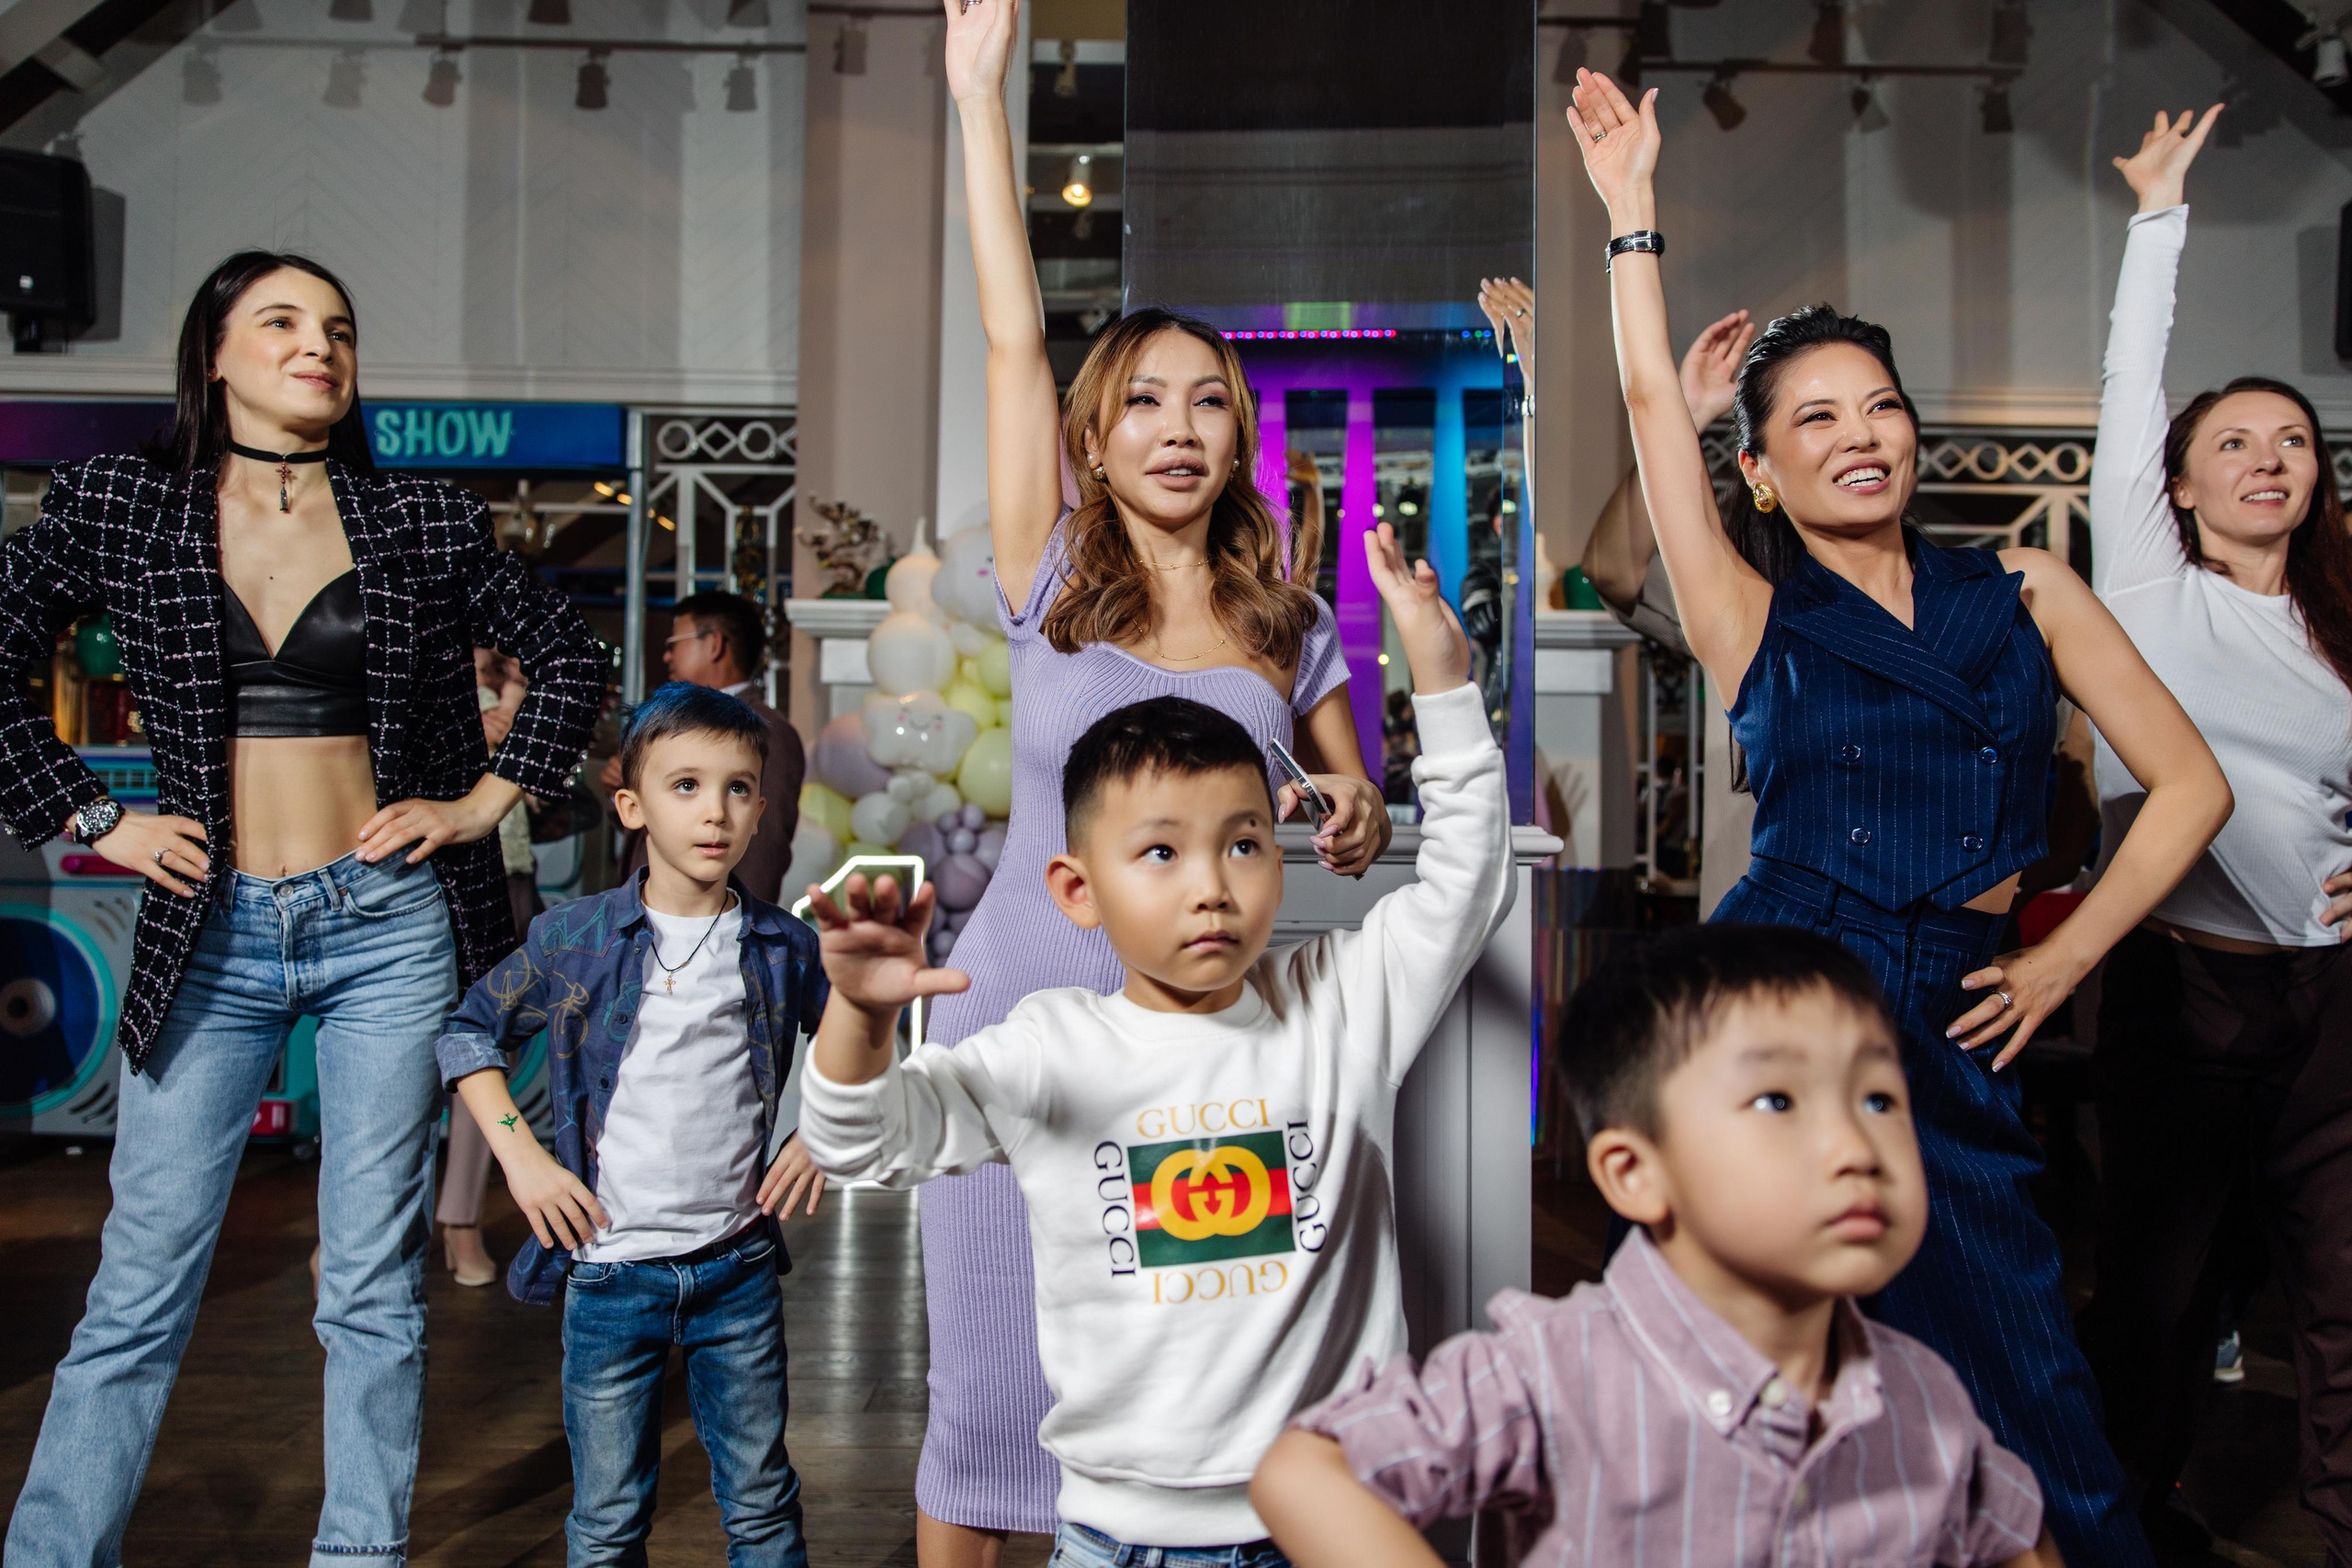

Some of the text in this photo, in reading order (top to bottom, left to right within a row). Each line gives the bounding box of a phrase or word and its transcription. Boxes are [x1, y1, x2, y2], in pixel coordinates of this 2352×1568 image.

[375, 410, 512, 457] SHOW
[1136, 1099, 1272, 1138] GUCCI
[1093, 1141, 1136, 1278] GUCCI
[1286, 1120, 1329, 1254] GUCCI
[1153, 1260, 1288, 1304] GUCCI
